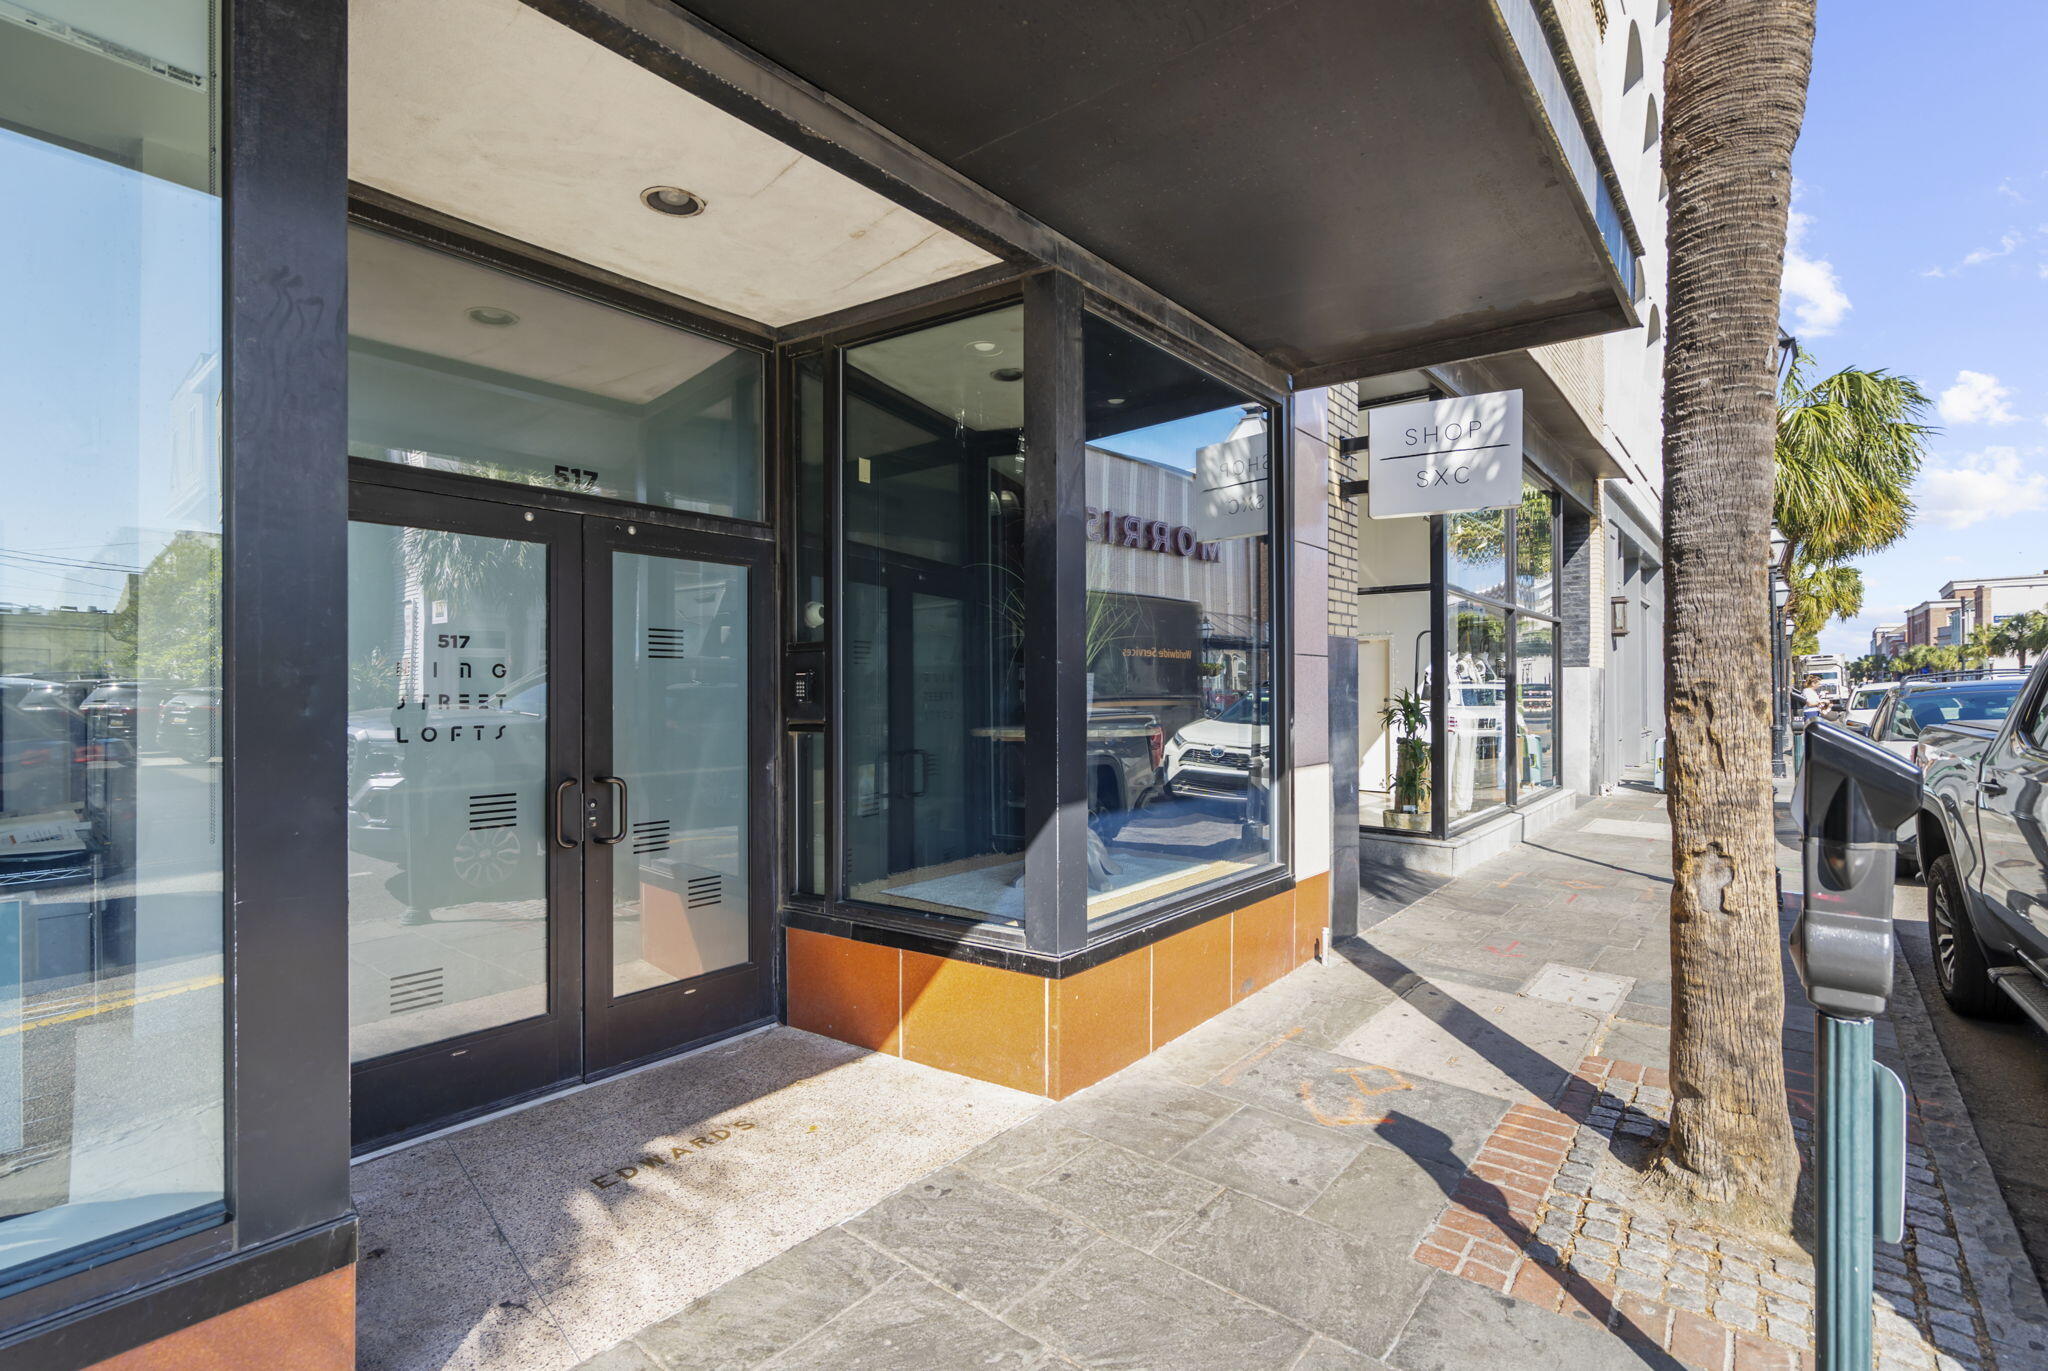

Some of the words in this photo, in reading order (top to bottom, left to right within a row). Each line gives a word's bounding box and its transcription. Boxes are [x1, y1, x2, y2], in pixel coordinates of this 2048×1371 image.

[1405, 420, 1482, 446] SHOP
[554, 464, 599, 489] 517
[1416, 466, 1470, 488] SXC
[437, 634, 471, 649] 517
[396, 661, 508, 679] ING
[396, 693, 508, 711] STREET
[396, 724, 507, 744] LOFTS
